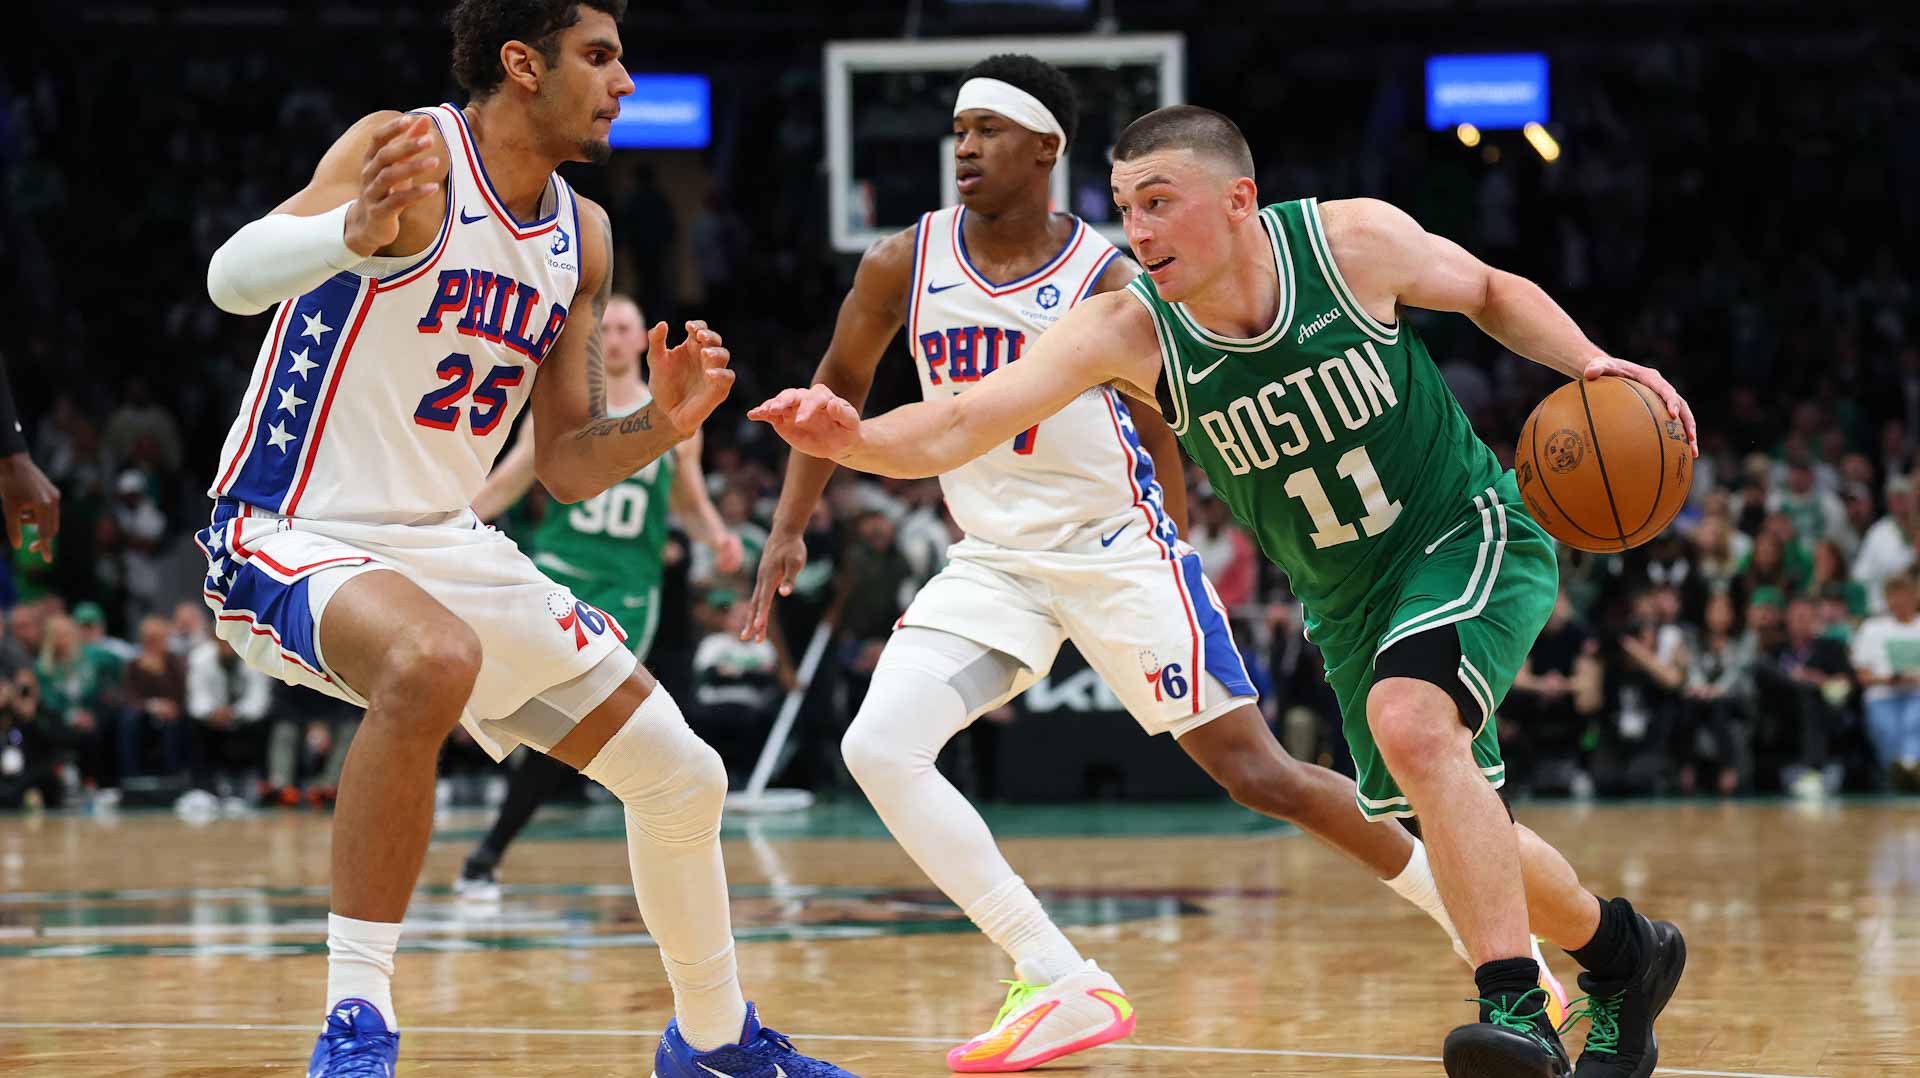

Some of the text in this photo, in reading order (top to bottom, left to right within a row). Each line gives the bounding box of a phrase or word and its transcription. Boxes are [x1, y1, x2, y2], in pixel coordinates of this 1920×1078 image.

[919, 325, 1026, 386] PHIL
[1297, 307, 1342, 345] Amica
[413, 352, 525, 437] 25
[1198, 340, 1398, 477] BOSTON
[569, 481, 648, 539] 30
[1283, 445, 1403, 549] 11
[555, 600, 606, 652] 76
[1144, 662, 1188, 702] 76
